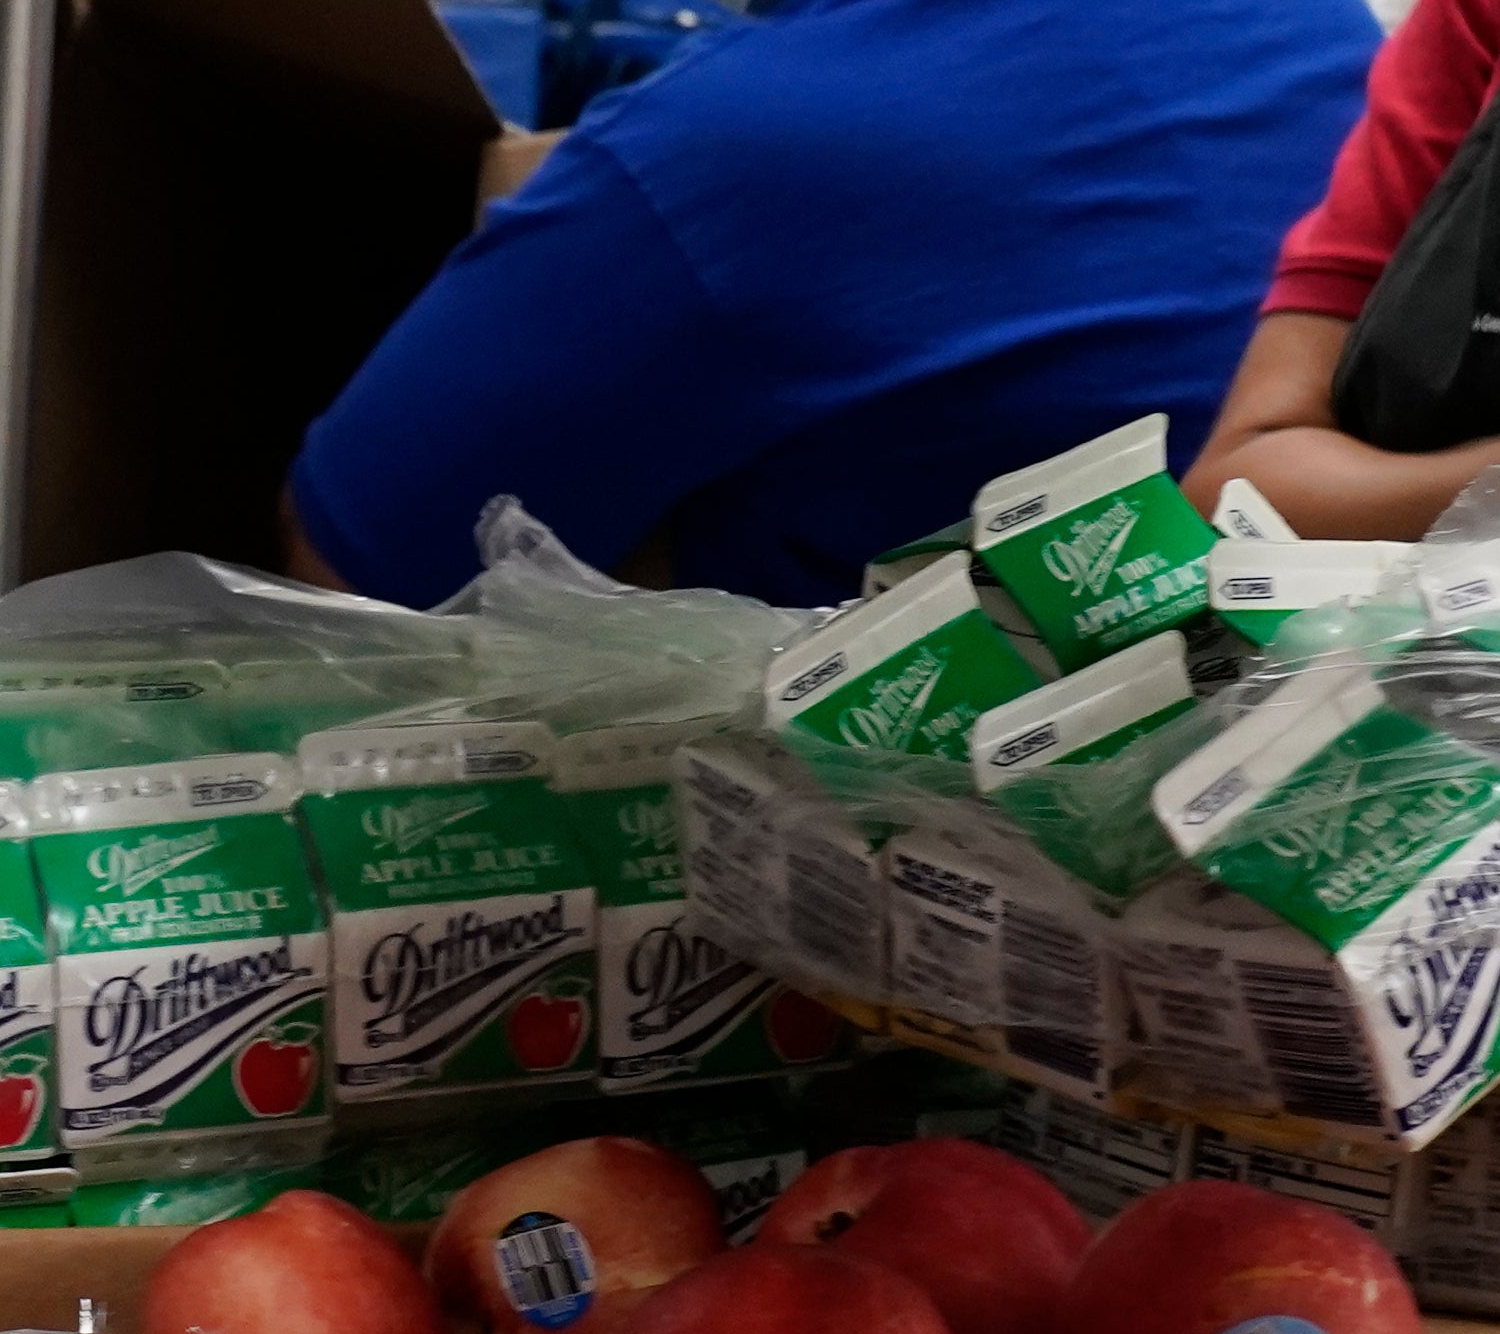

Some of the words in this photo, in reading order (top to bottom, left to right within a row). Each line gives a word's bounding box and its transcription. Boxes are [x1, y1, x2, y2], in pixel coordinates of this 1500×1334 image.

[1074, 585, 1150, 637] APPLE
[361, 855, 455, 885] APPLE
[472, 845, 561, 872] JUICE
[82, 896, 190, 927] APPLE
[194, 887, 289, 918] JUICE
[362, 895, 564, 1030] Driftwood
[86, 934, 292, 1074] Driftwood
